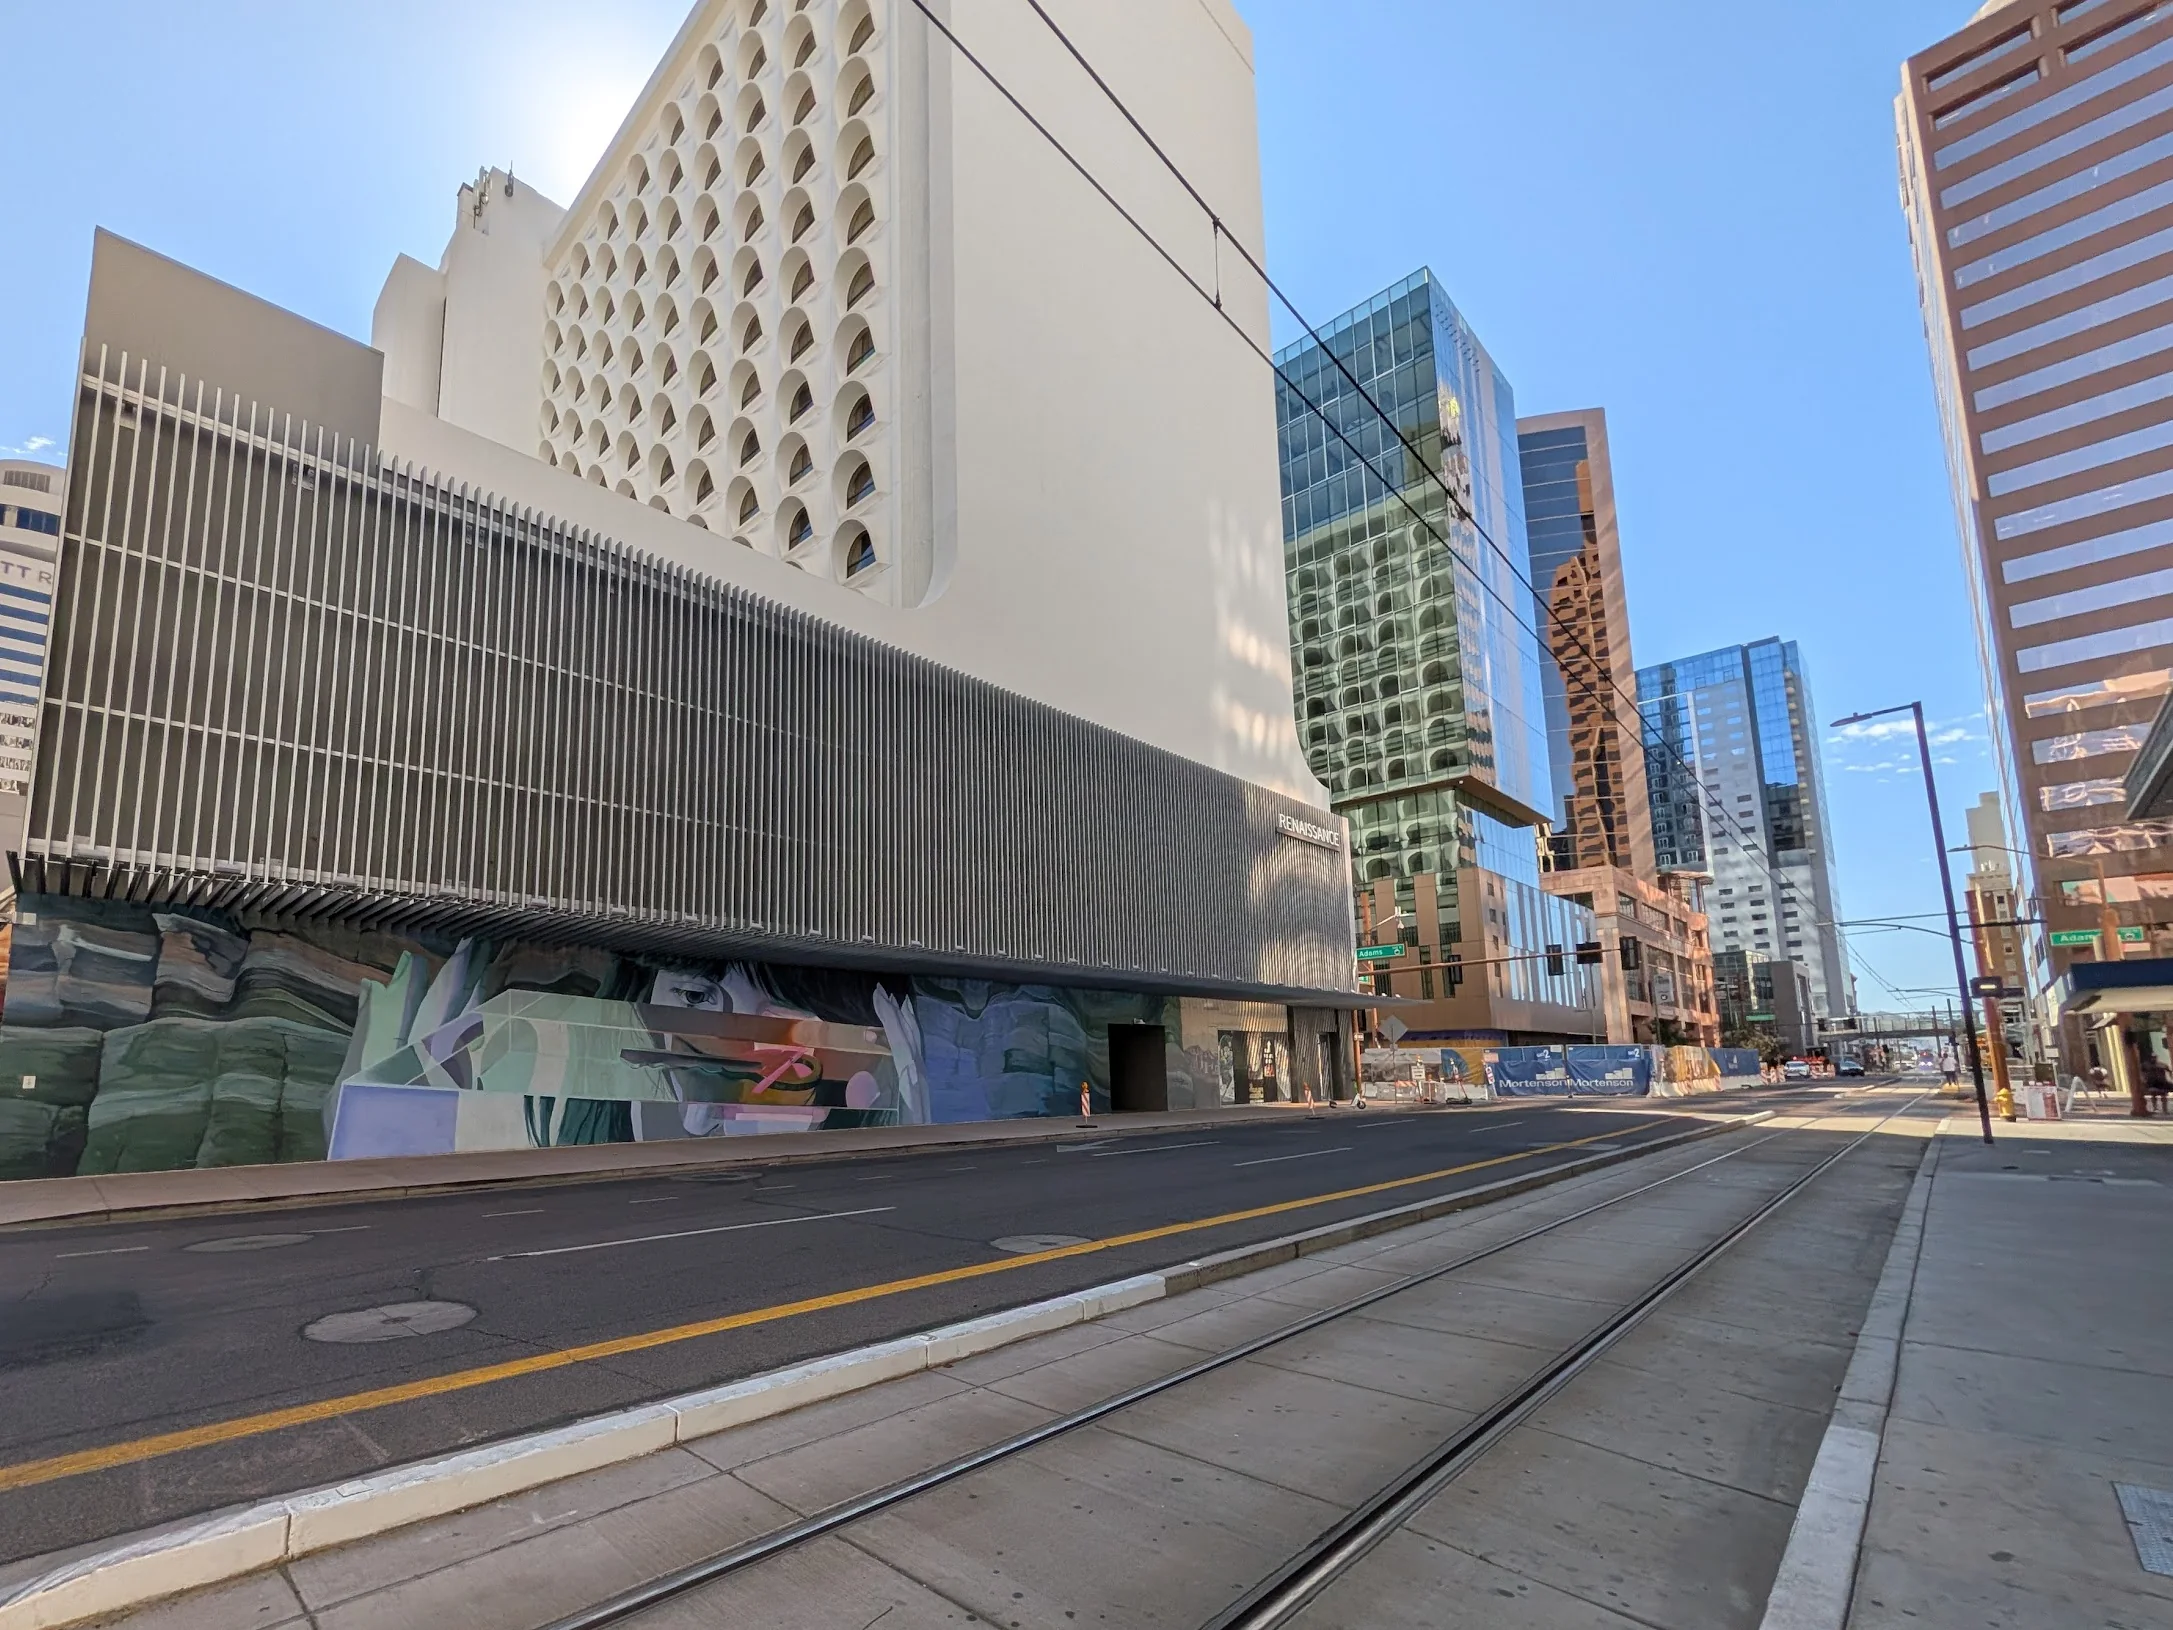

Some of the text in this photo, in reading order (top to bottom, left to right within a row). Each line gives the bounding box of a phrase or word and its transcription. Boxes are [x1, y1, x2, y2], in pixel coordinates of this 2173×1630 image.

[1278, 813, 1340, 847] RENAISSANCE
[2060, 934, 2094, 942] Adam
[1499, 1079, 1568, 1088] Mortenson
[1570, 1079, 1634, 1087] Mortenson
